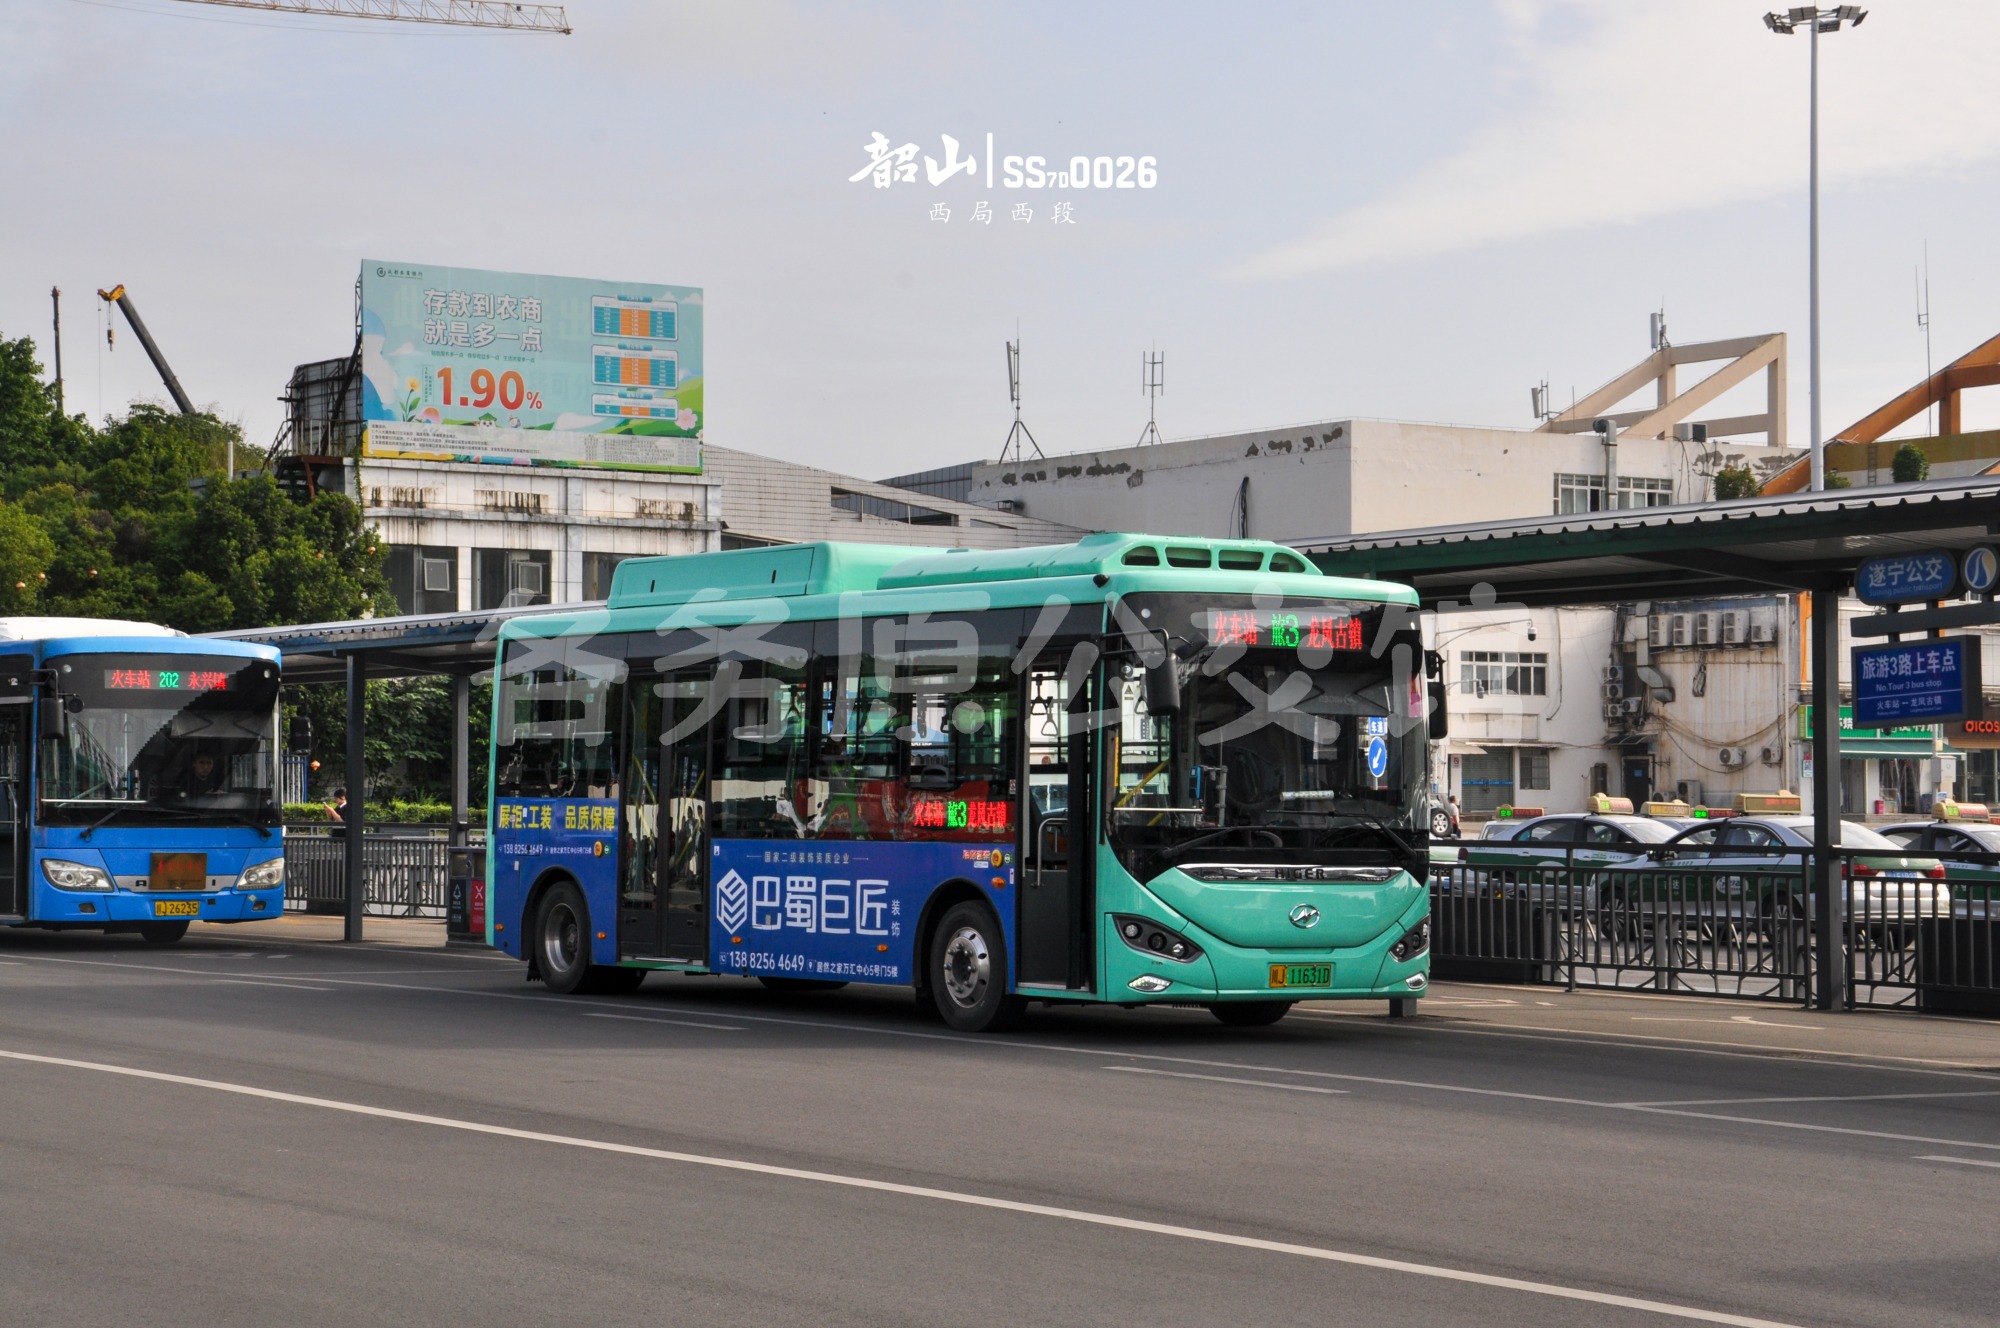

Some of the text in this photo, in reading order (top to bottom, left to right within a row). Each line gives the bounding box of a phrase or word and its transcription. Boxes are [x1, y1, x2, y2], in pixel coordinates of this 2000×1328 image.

[423, 288, 543, 323] 存款到农商
[423, 318, 543, 352] 就是多一点
[437, 367, 543, 410] 1.90%
[1868, 557, 1943, 588] 遂宁公交
[1214, 610, 1259, 645] 火车站
[1306, 615, 1363, 650] 龙凤古镇
[1862, 648, 1956, 680] 旅游3路上车点
[111, 669, 227, 690] 火车站 202 永兴镇
[1911, 680, 1924, 689] bus
[1925, 680, 1942, 689] stop
[565, 805, 616, 831] 品质保障
[503, 844, 514, 854] 138
[764, 851, 850, 864] 国家二级装饰资质企业
[1274, 868, 1325, 880] HIGER
[751, 876, 889, 935] 巴蜀巨匠
[730, 951, 805, 971] 138 8256 4649
[816, 962, 899, 978] 居然之家万汇中心5号门5楼
